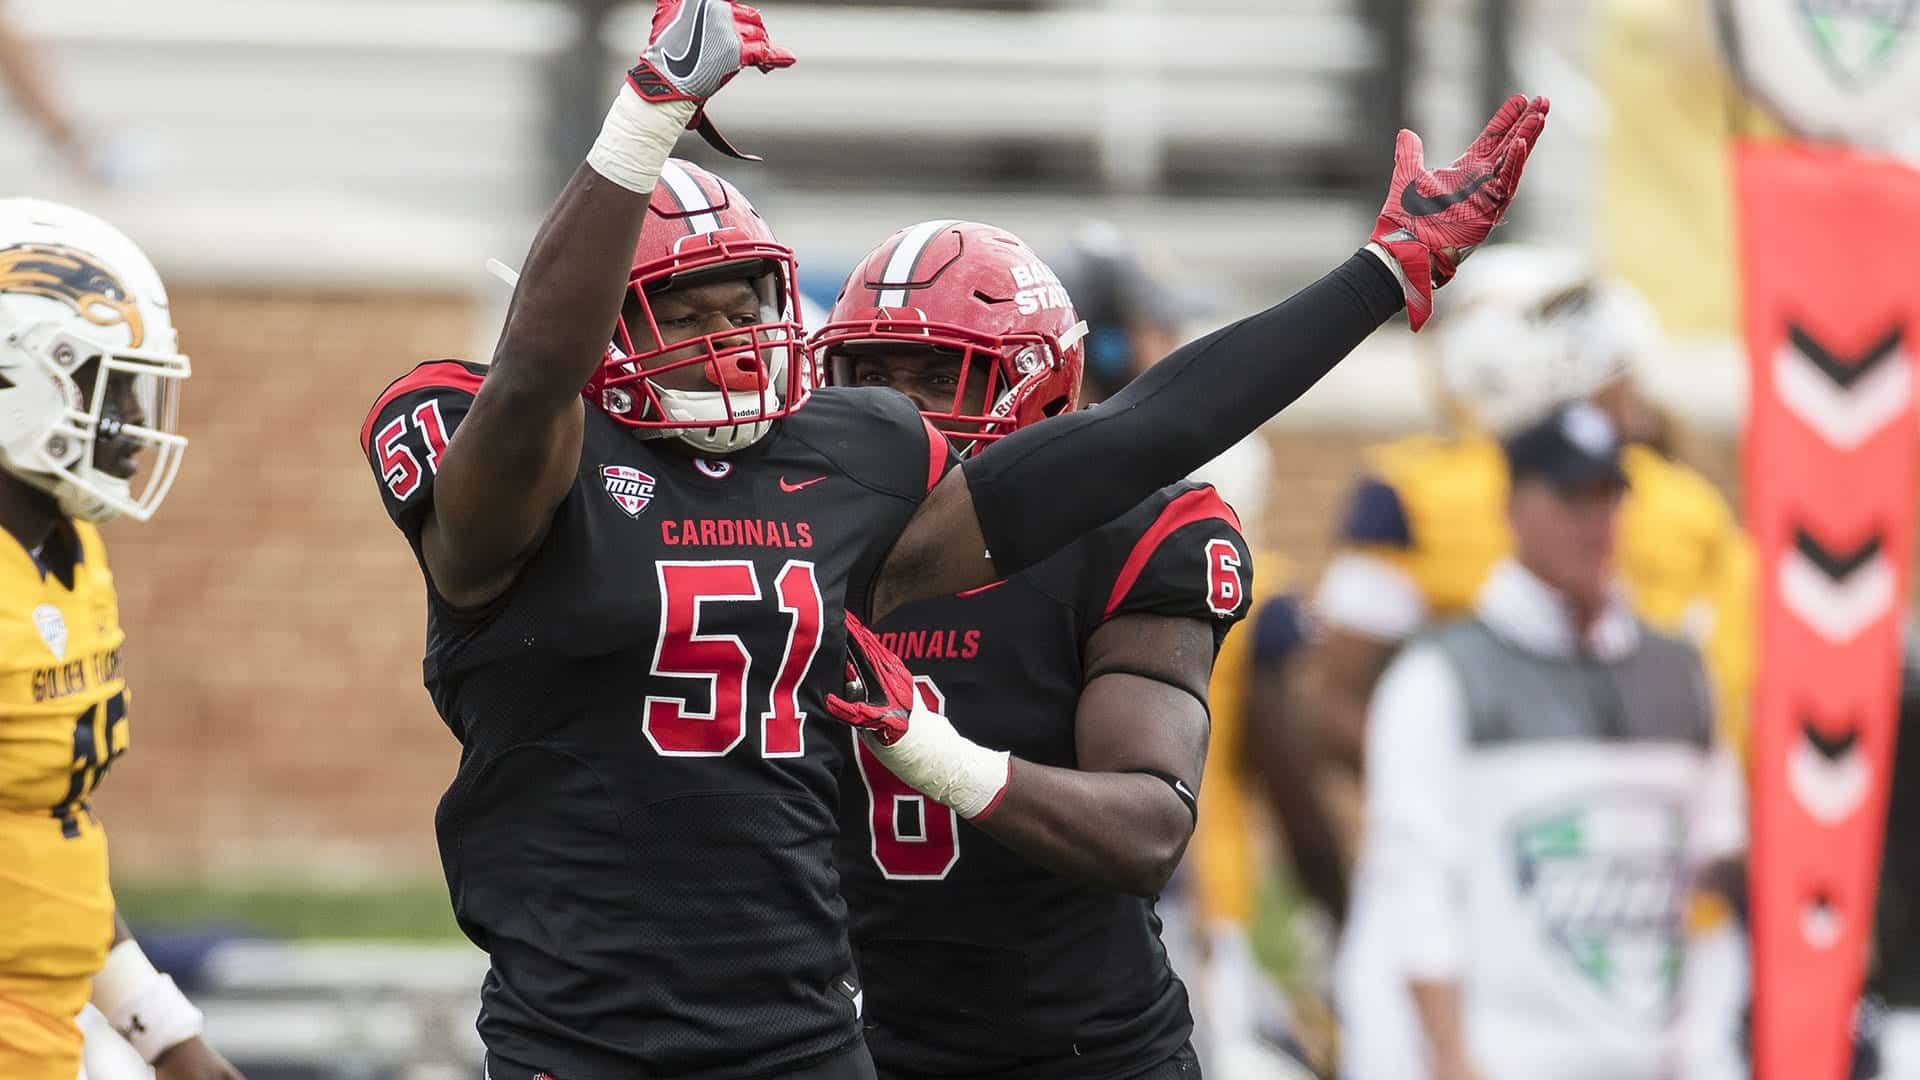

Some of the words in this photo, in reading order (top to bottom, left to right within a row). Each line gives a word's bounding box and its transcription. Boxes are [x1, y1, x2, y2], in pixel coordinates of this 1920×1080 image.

[375, 398, 450, 501] 51
[605, 477, 655, 498] MAC
[661, 519, 814, 548] CARDINALS
[1204, 538, 1243, 614] 6
[641, 559, 826, 759] 51
[873, 629, 982, 661] DINALS
[851, 675, 960, 880] 6
